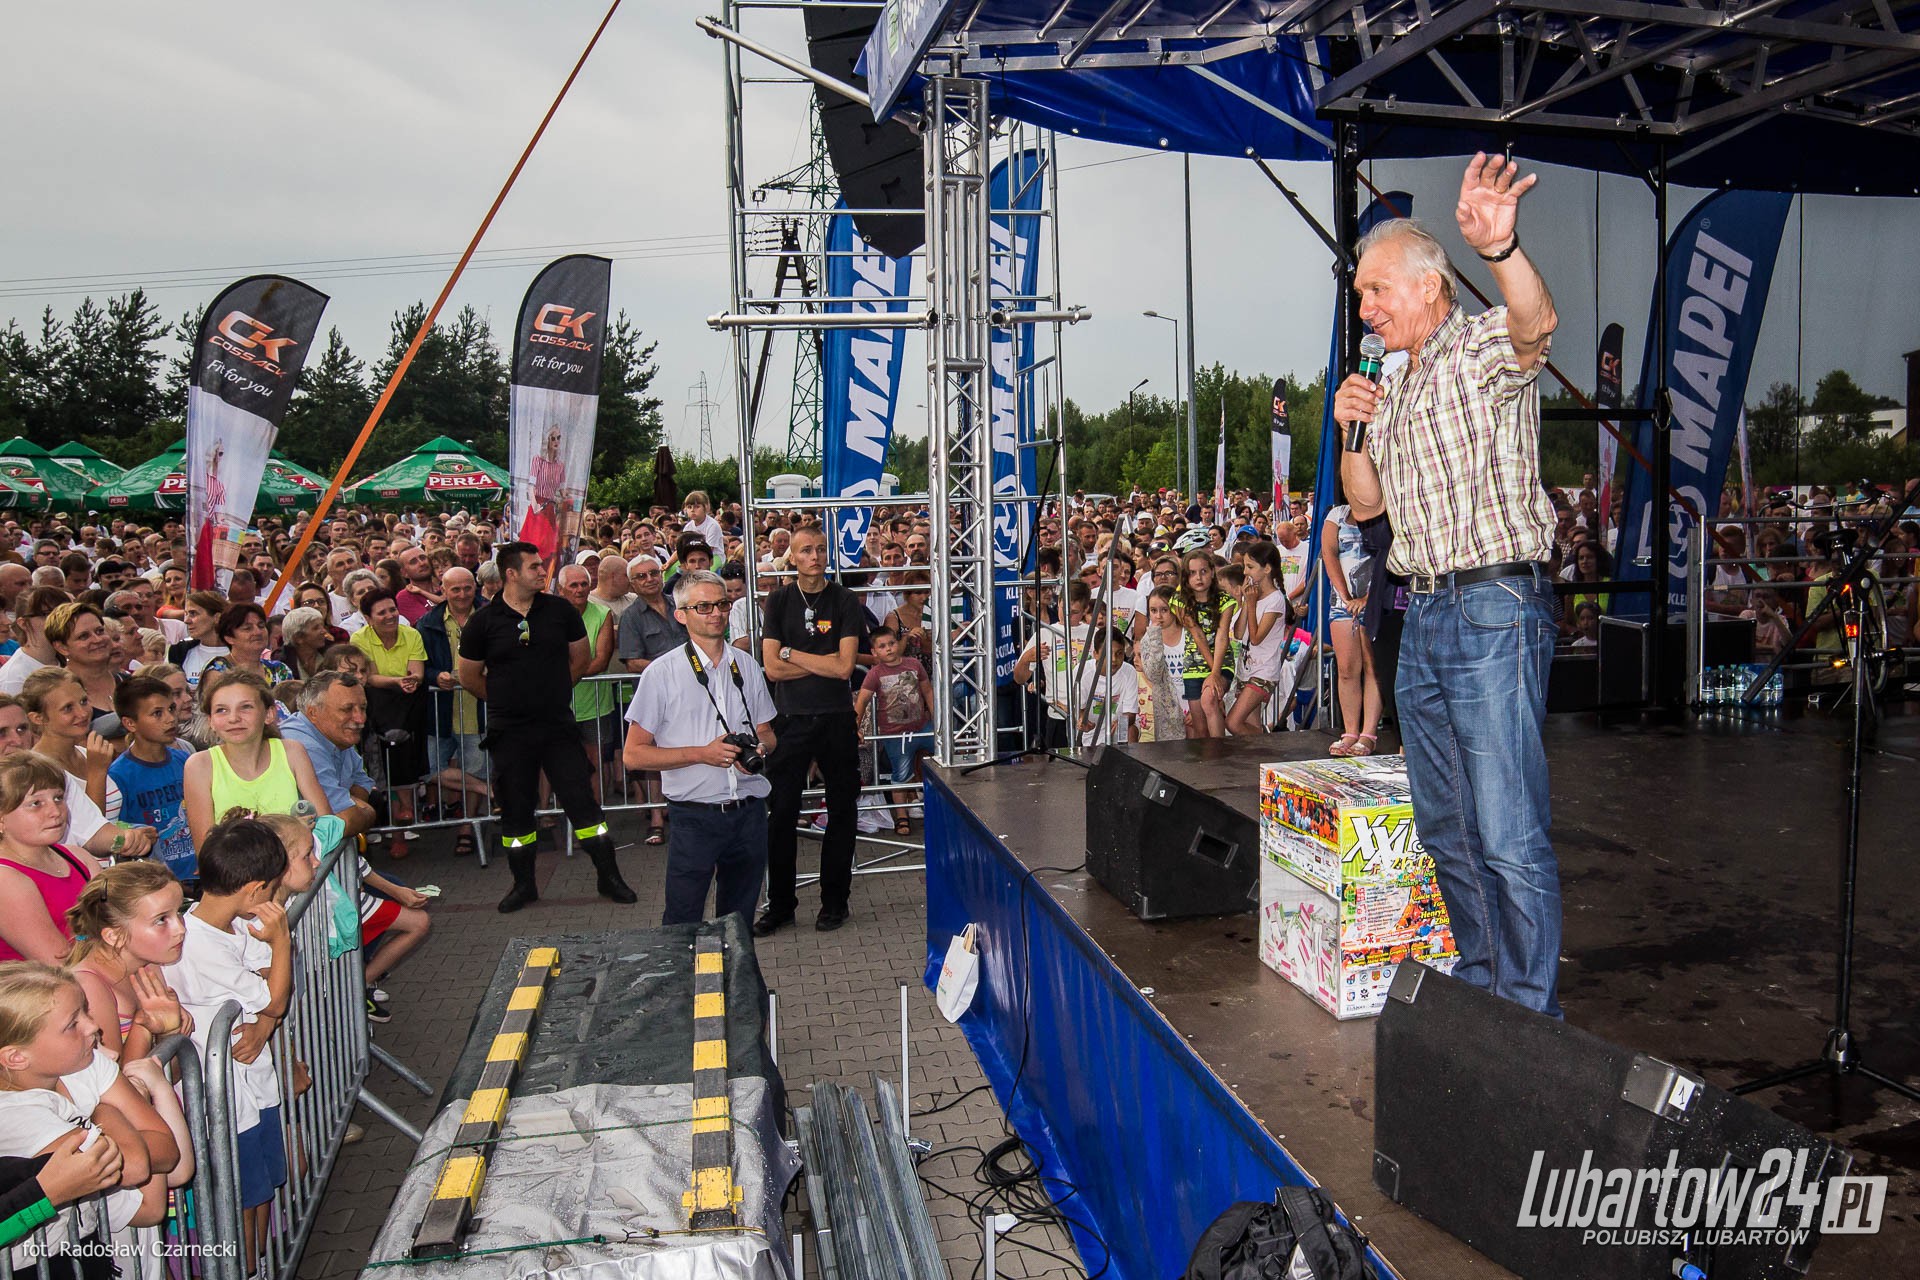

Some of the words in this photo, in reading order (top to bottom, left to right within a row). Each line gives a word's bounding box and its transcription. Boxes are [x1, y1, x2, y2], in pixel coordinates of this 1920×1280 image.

[208, 335, 288, 378] COSSACK
[529, 333, 595, 352] COSSACK
[846, 222, 898, 464] MAPE
[1669, 229, 1754, 475] MAPEI
[206, 359, 226, 374] Fit
[224, 368, 247, 384] for
[239, 381, 274, 397] you
[531, 355, 546, 368] Fit
[547, 357, 565, 370] for
[562, 362, 584, 375] you
[429, 475, 492, 487] PERŁA
